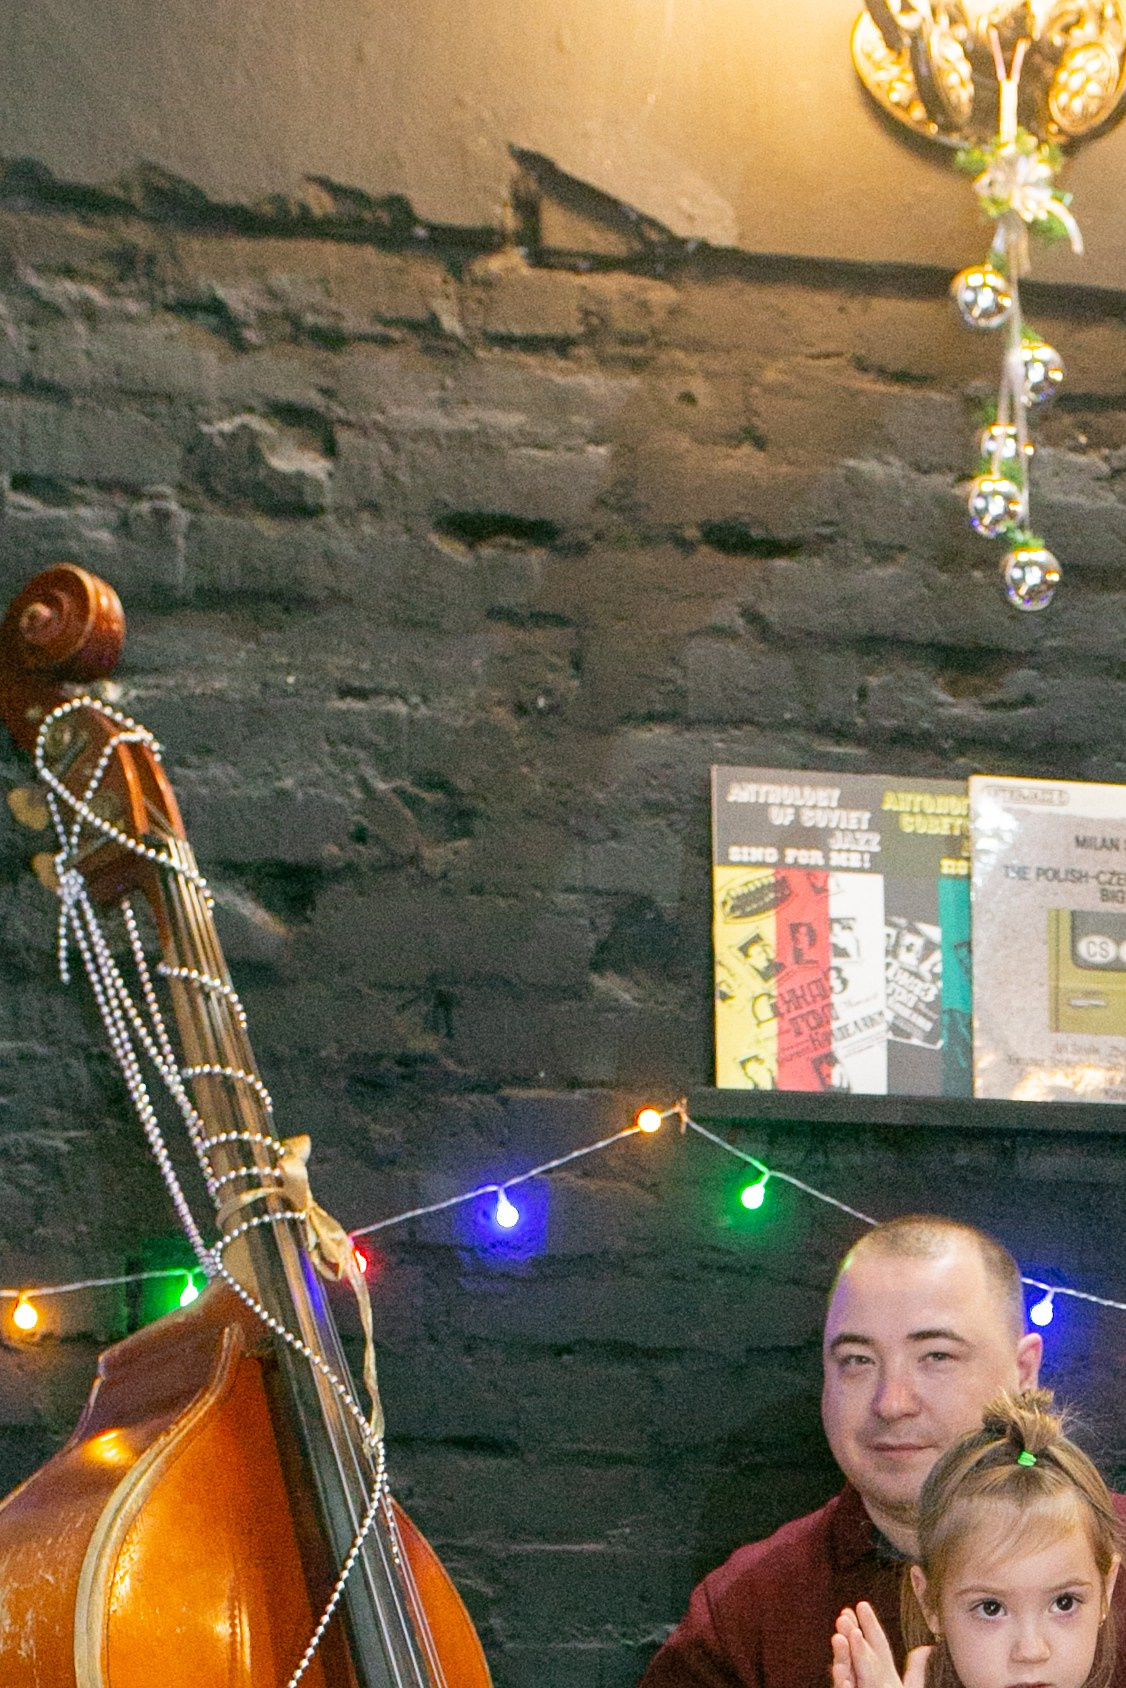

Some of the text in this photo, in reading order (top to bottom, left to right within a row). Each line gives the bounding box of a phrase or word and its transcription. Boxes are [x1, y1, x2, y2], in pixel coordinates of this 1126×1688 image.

[768, 805, 871, 830] OF SOVIET
[830, 830, 881, 852] JAZZ
[1075, 836, 1120, 852] MILAN
[784, 847, 825, 866] FOR
[1100, 888, 1125, 904] BIG
[1086, 940, 1110, 959] CS
